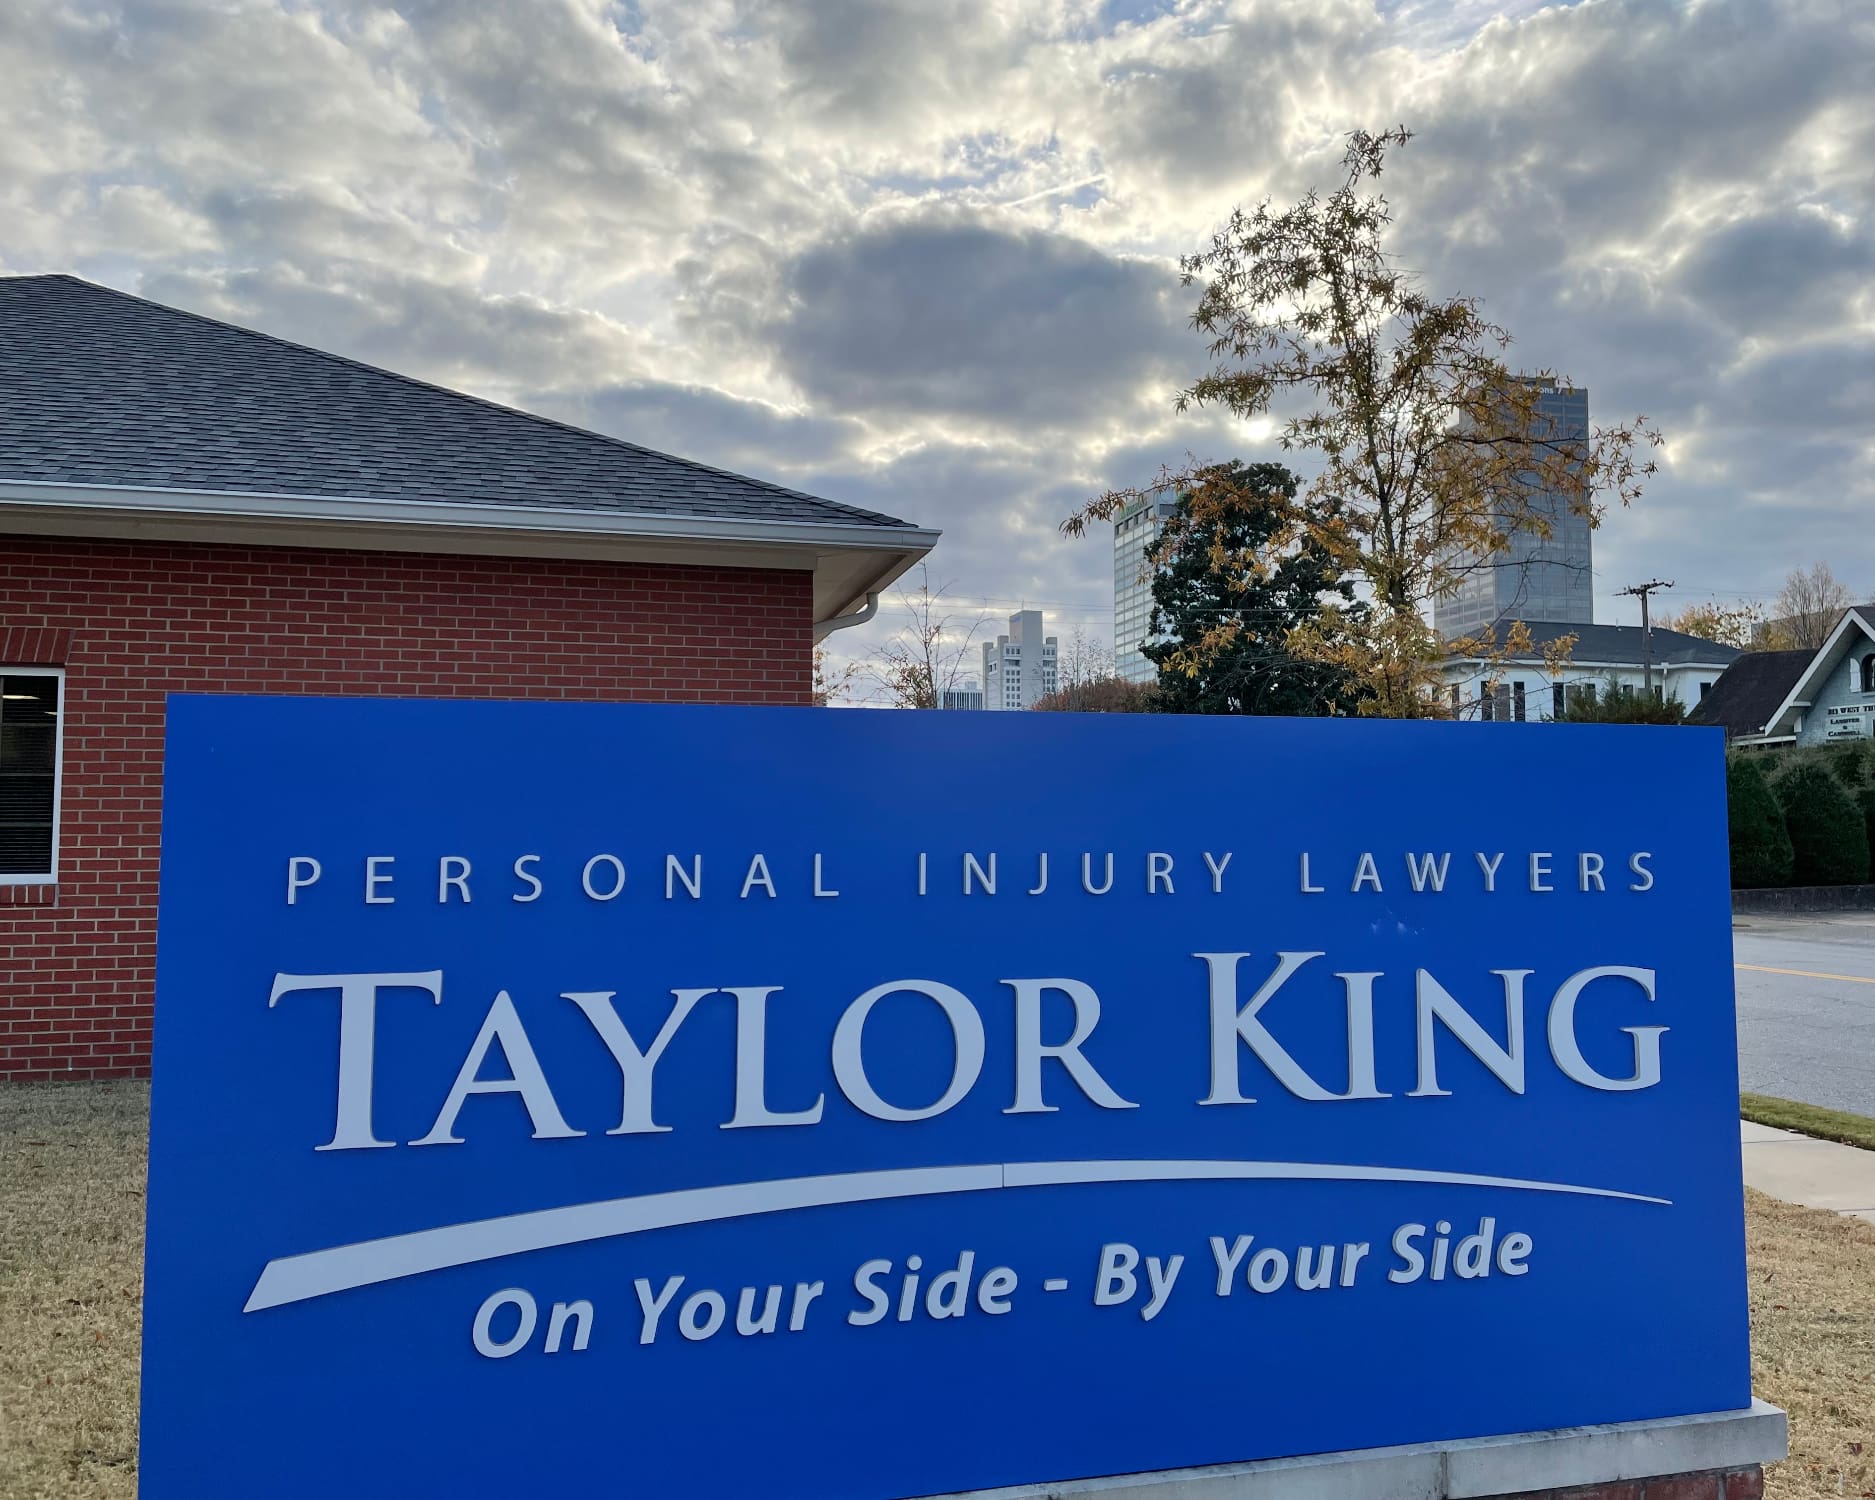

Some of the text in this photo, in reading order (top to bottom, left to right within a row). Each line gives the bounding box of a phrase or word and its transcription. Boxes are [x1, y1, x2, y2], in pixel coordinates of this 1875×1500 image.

[287, 851, 1657, 905] PERSONAL INJURY LAWYERS
[269, 950, 1670, 1152] TAYLOR KING
[472, 1216, 1534, 1360] On Your Side - By Your Side
